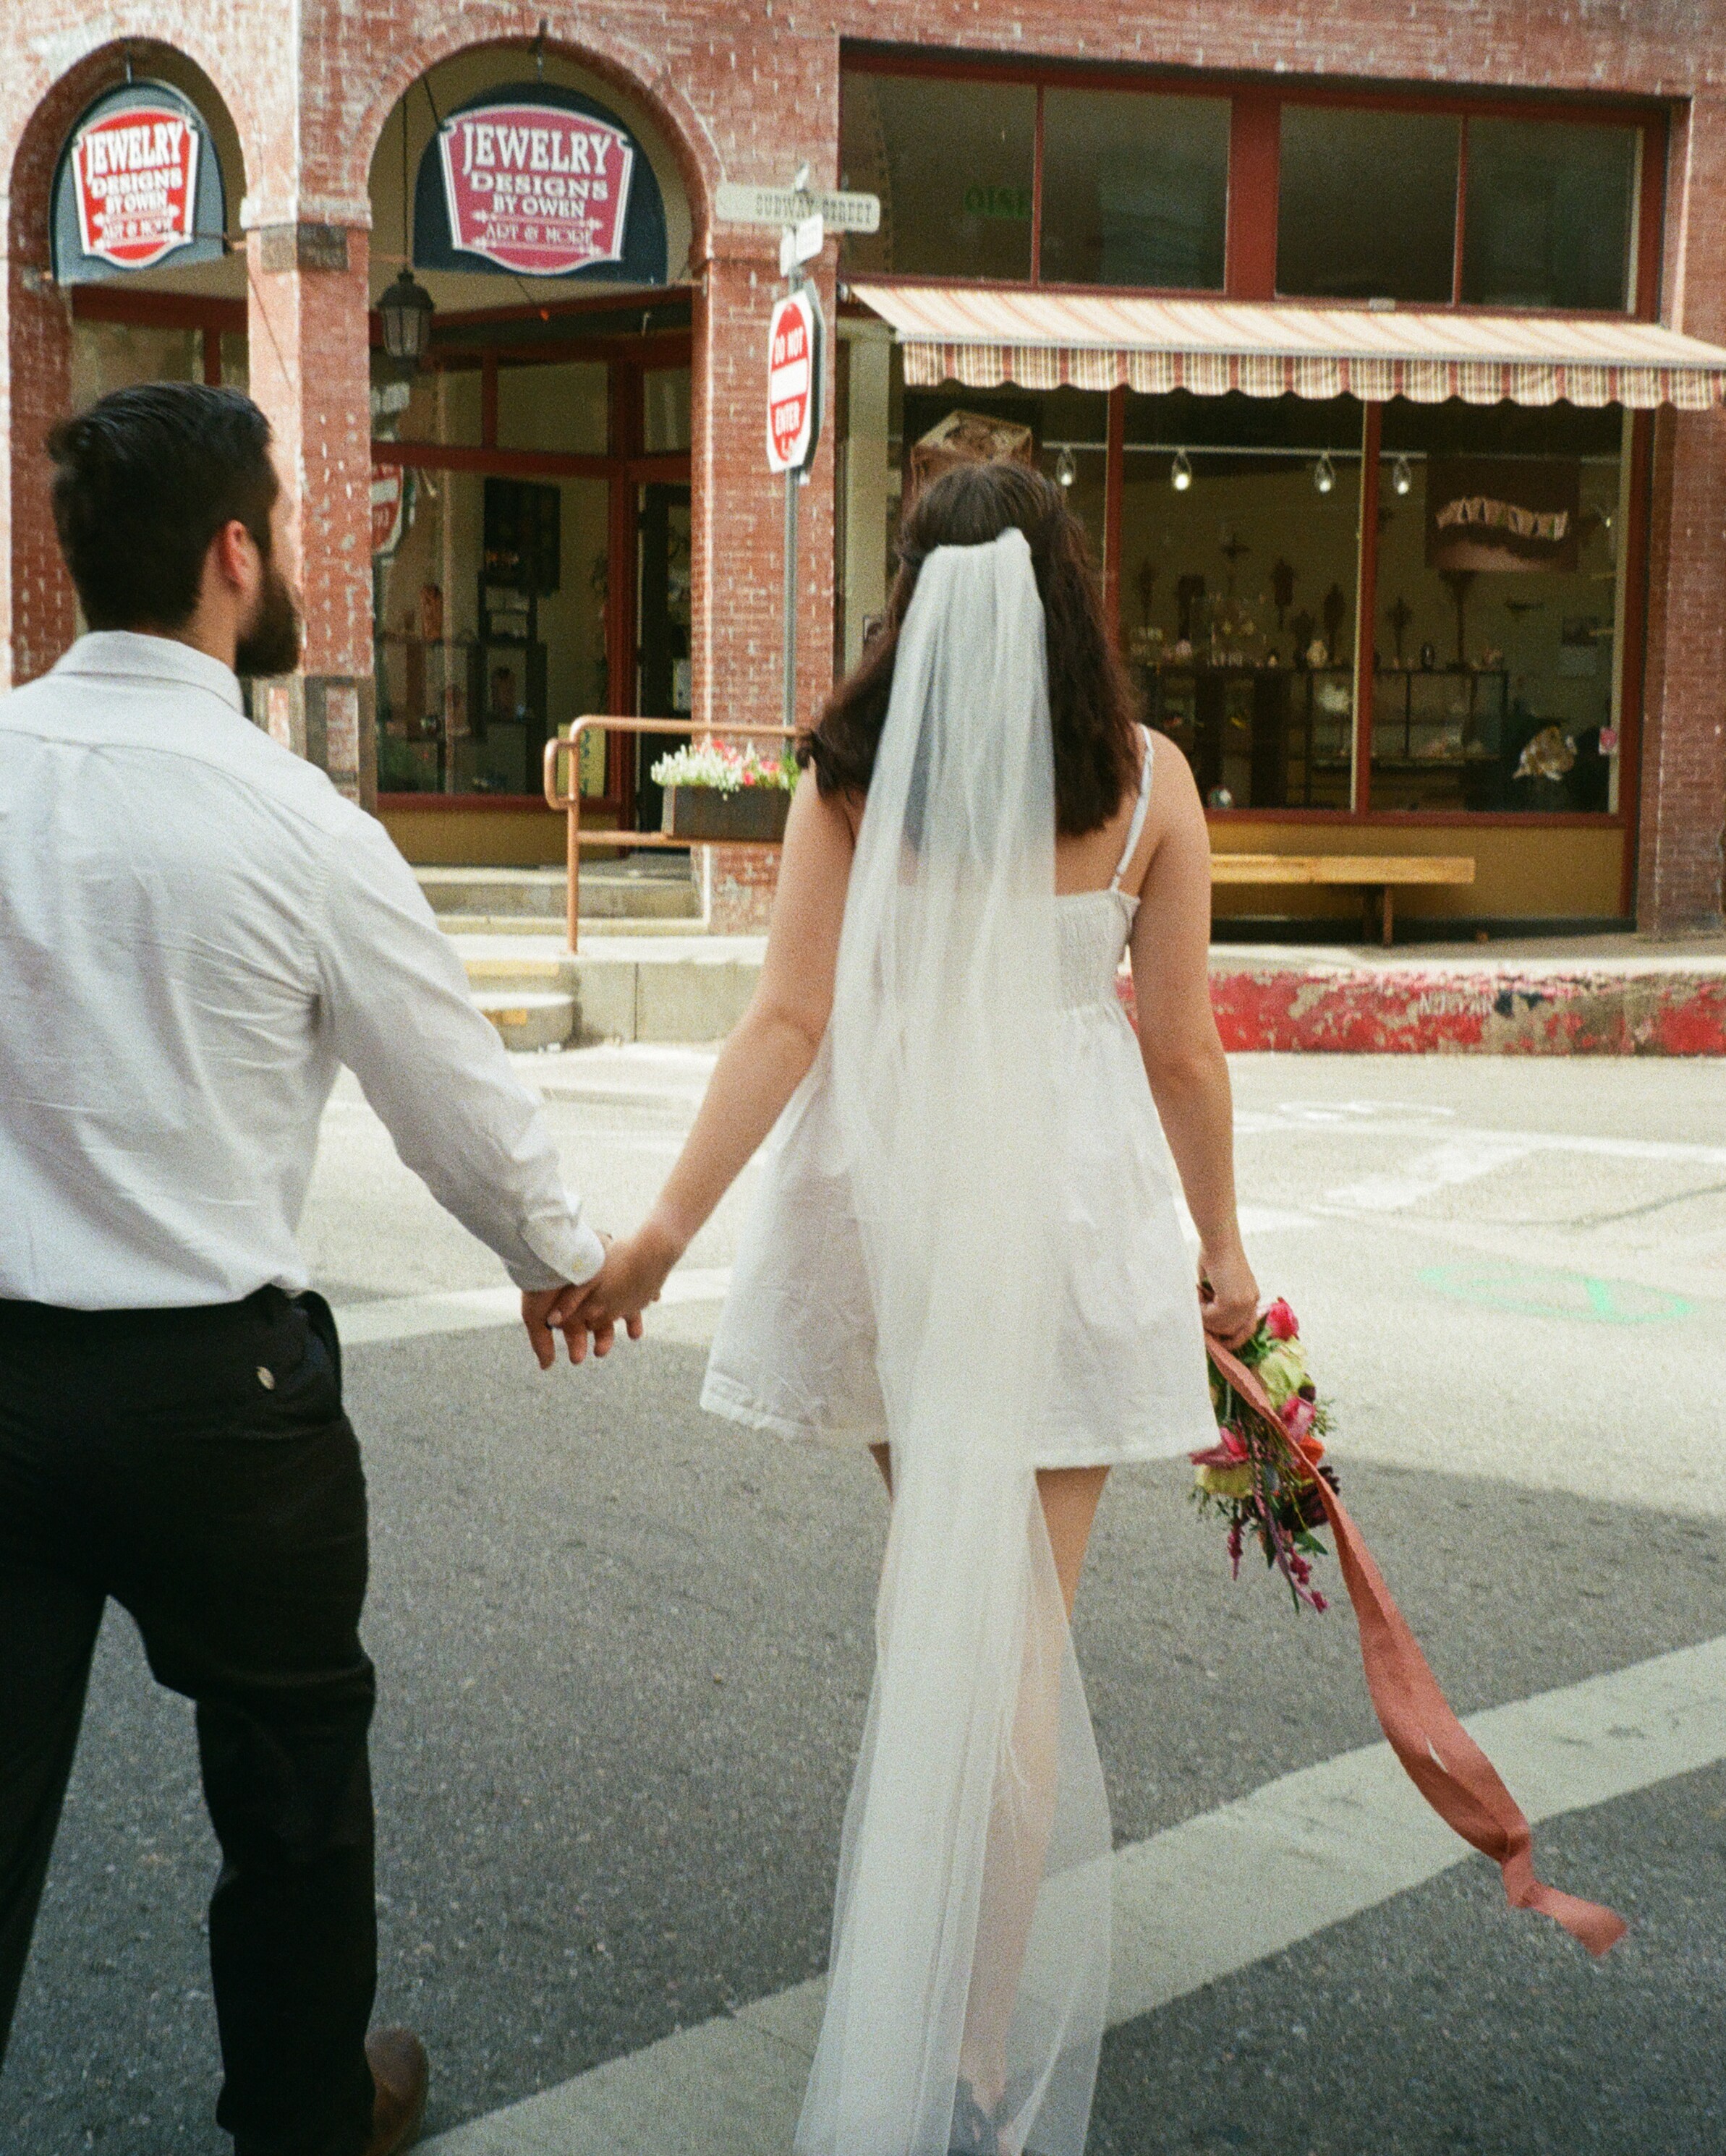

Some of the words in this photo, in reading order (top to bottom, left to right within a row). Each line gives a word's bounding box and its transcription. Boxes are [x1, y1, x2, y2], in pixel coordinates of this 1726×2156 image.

[86, 121, 183, 187] JEWELRY
[462, 123, 612, 175] JEWELRY
[91, 166, 183, 199] DESIGNS
[471, 171, 608, 200] DESIGNS
[493, 194, 519, 213] BY
[522, 195, 586, 218] OWEN
[822, 198, 872, 224] STREET
[774, 333, 786, 365] DO
[787, 326, 804, 359] NOT
[775, 399, 800, 436] ENTER
